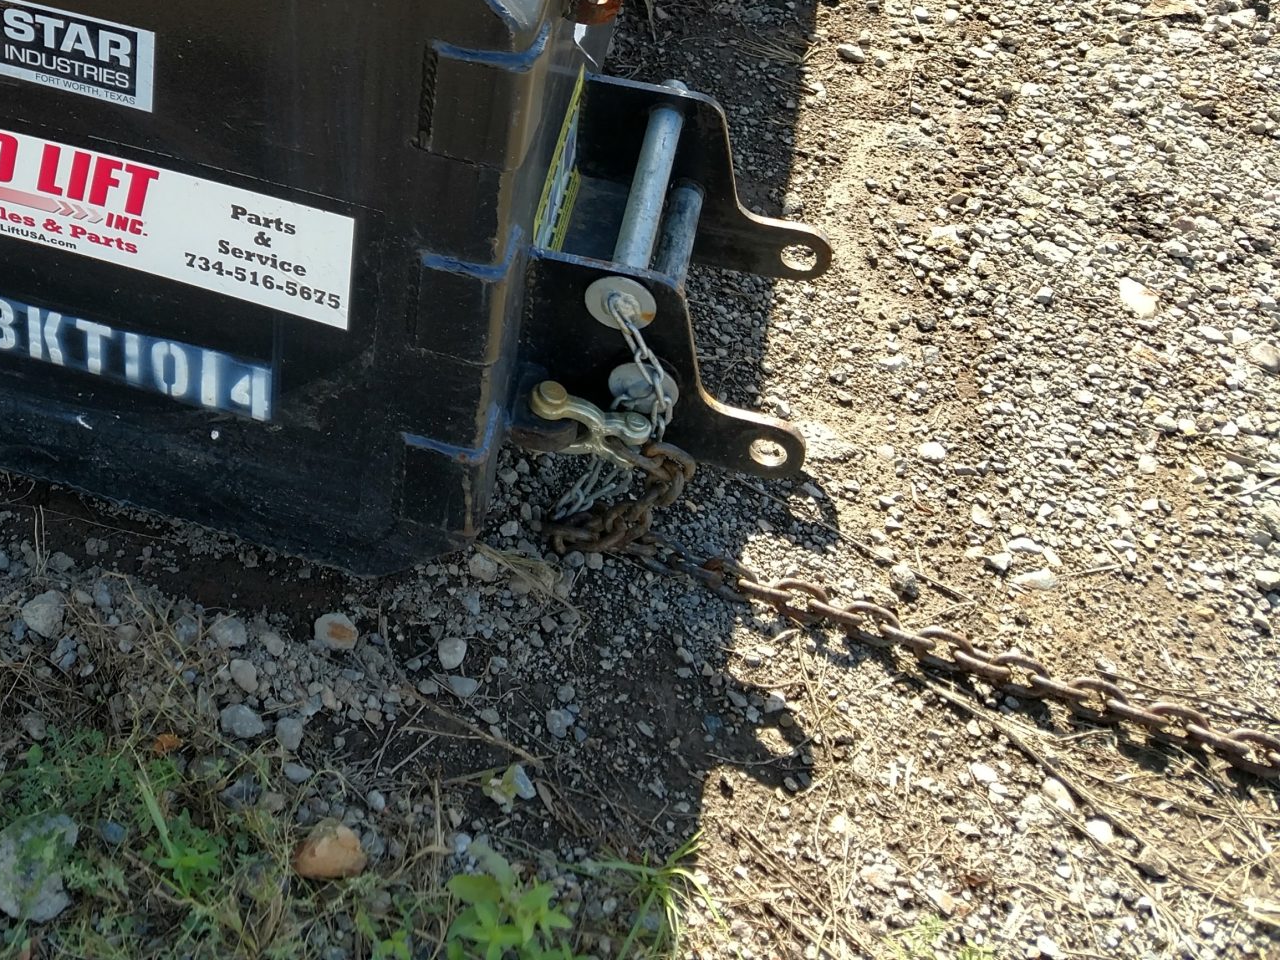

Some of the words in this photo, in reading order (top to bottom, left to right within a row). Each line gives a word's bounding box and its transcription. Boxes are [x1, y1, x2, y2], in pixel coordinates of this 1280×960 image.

[3, 8, 131, 68] STAR
[4, 44, 129, 89] INDUSTRIES
[35, 73, 61, 87] FORT
[63, 79, 101, 97] WORTH,
[104, 90, 136, 105] TEXAS
[37, 144, 159, 216] LIFT
[42, 217, 62, 235] &
[69, 224, 138, 254] Parts
[105, 213, 148, 236] INC.
[231, 204, 296, 235] Parts
[254, 231, 271, 248] &
[218, 240, 306, 276] Service
[184, 252, 341, 309] 734-516-5675
